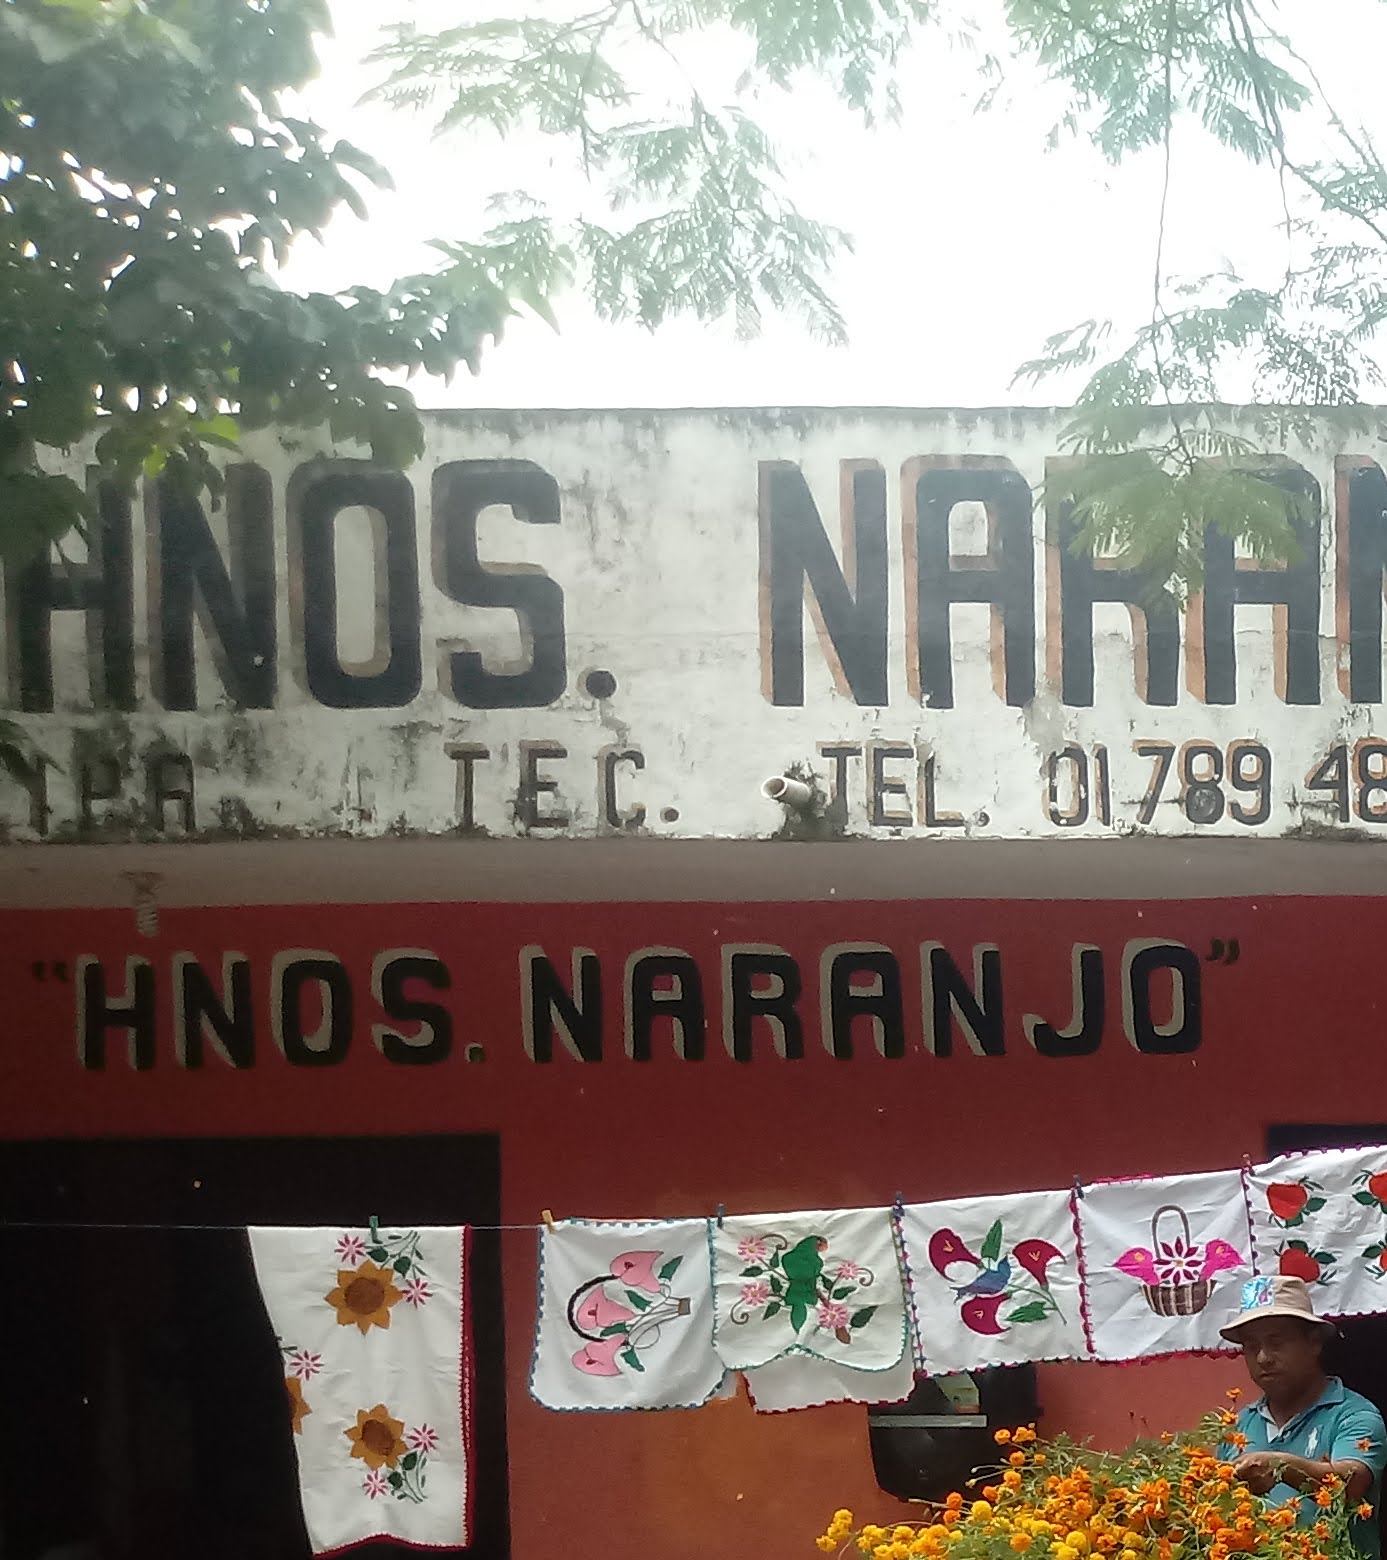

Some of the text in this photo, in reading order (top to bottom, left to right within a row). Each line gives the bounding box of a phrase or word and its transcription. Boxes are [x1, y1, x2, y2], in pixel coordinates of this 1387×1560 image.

[5, 457, 618, 711] HNOS.
[443, 738, 681, 835] TEC.
[815, 738, 990, 829] TEL.
